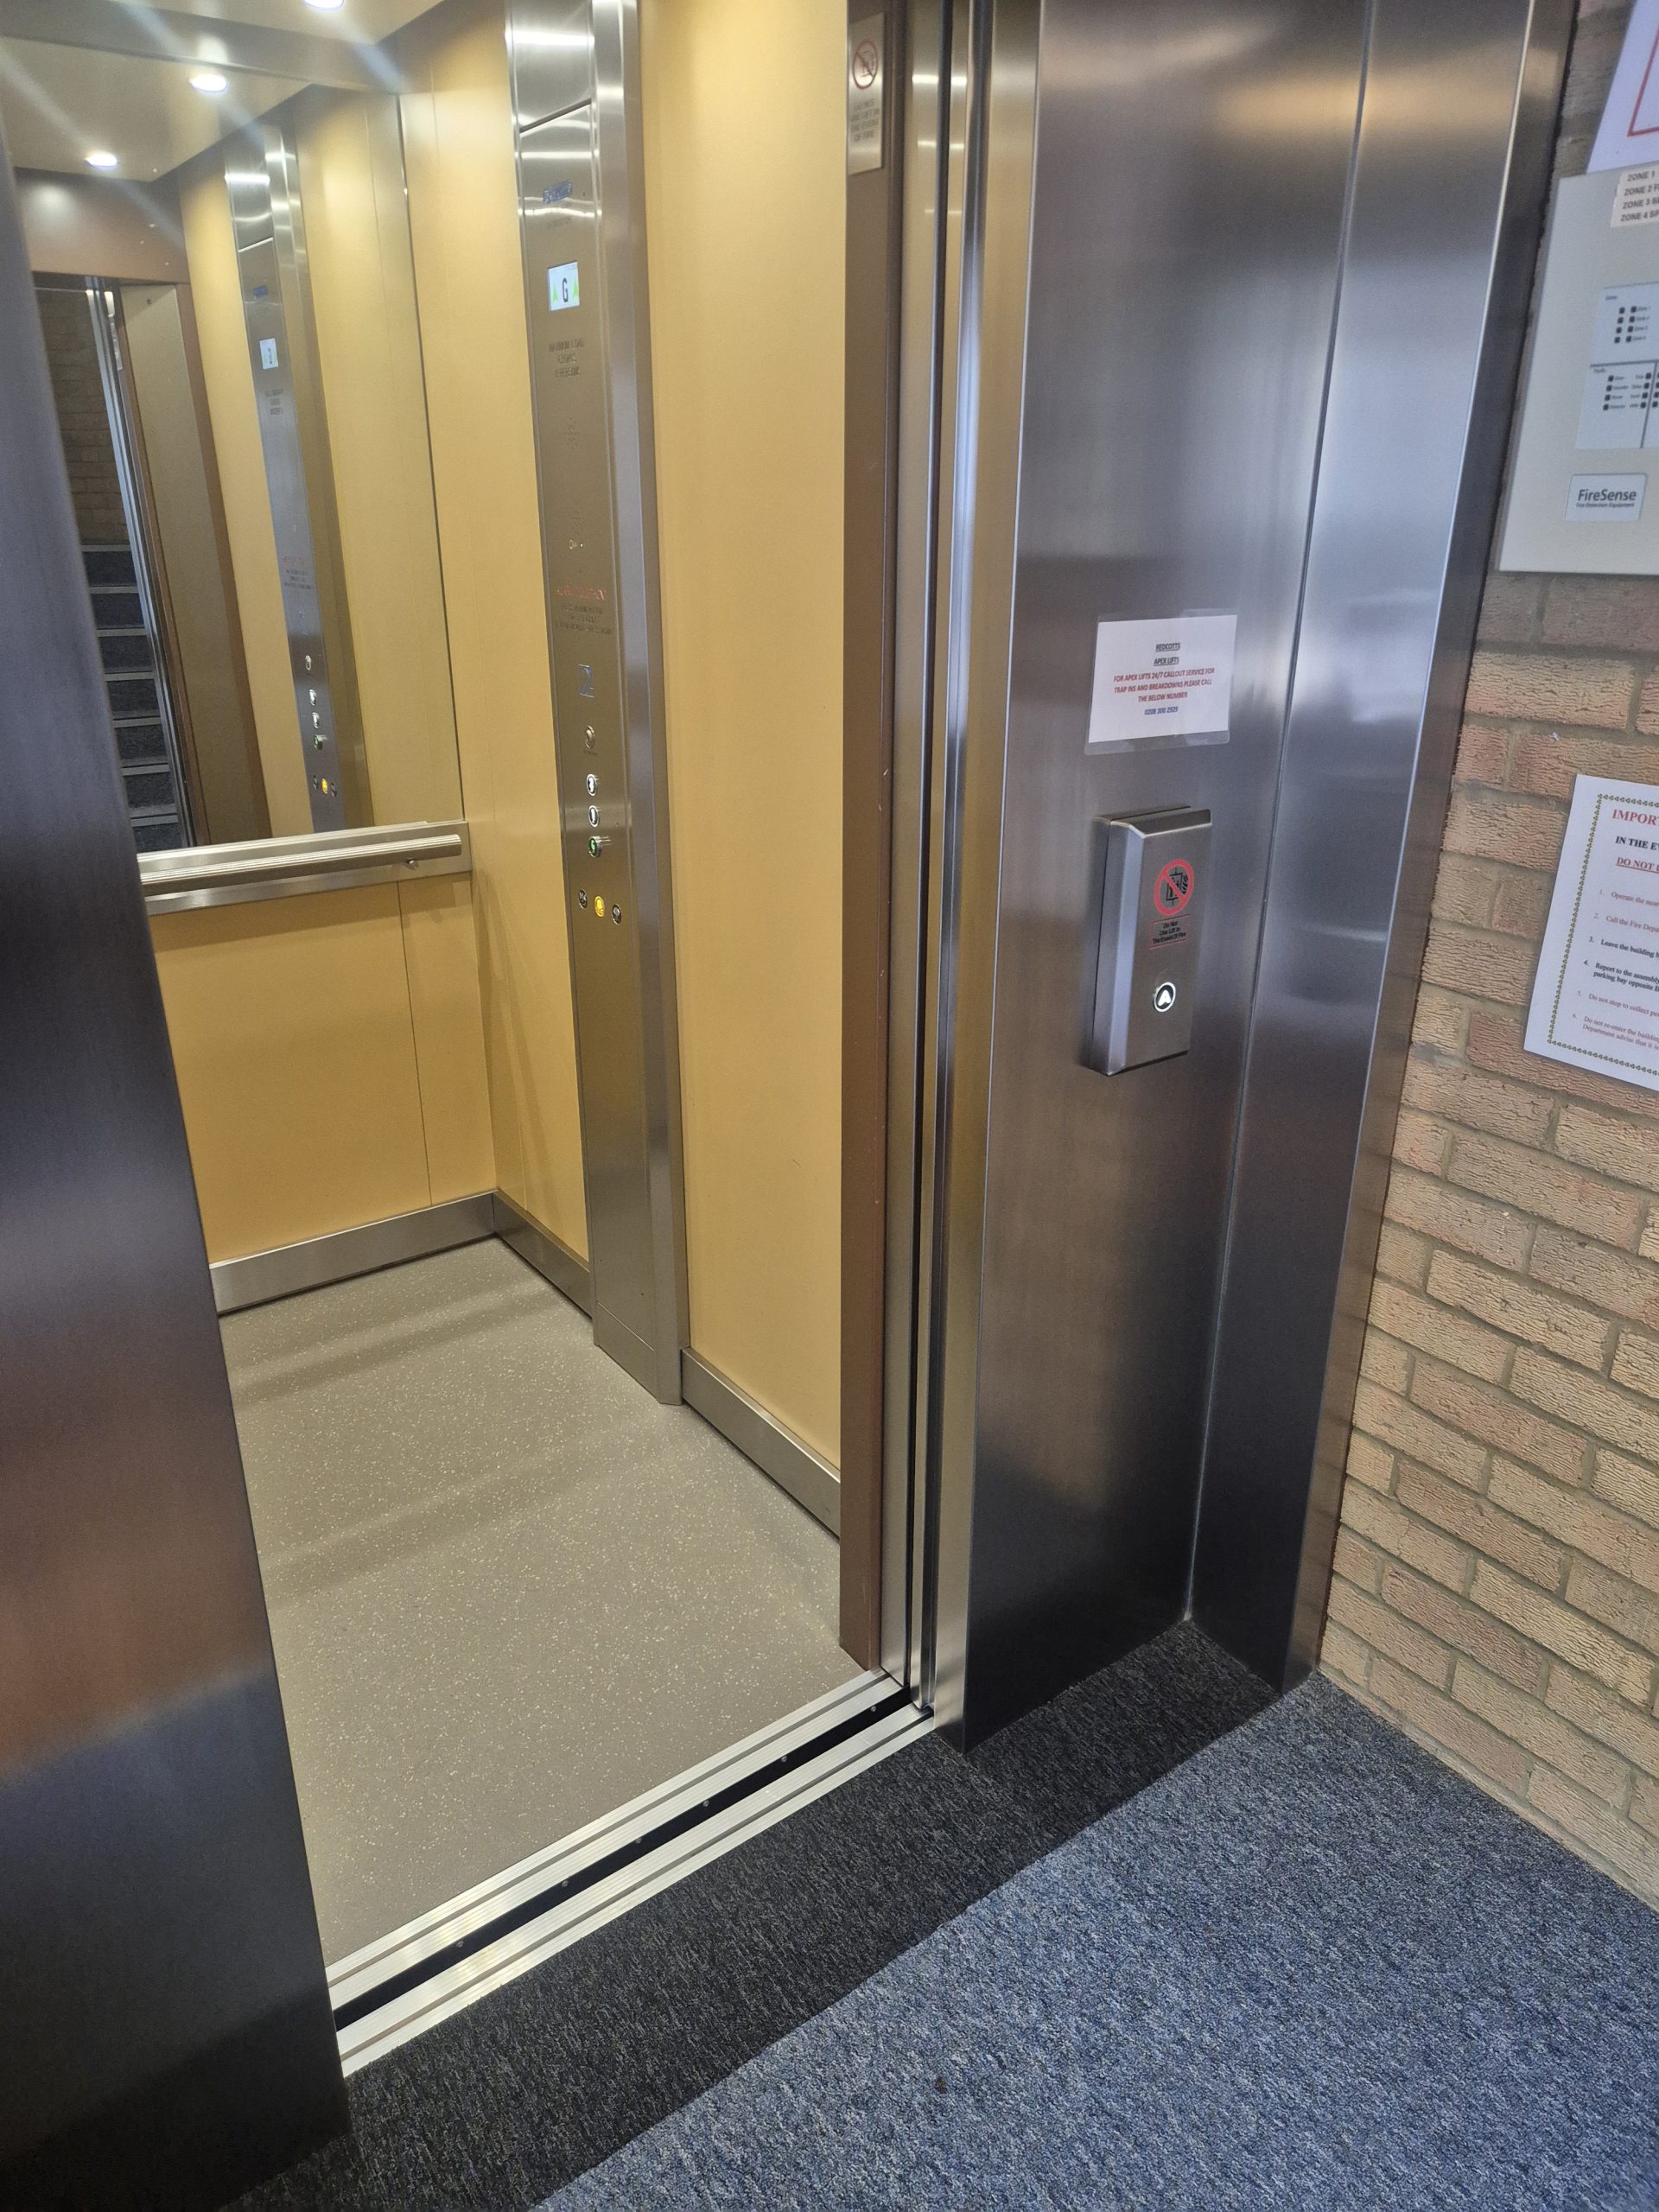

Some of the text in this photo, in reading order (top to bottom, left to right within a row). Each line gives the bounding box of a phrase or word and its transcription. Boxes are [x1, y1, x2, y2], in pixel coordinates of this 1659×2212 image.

[1627, 171, 1649, 181] ZONE
[1624, 186, 1645, 196] ZONE
[1623, 200, 1643, 209] ZONE
[1620, 213, 1642, 222] ZONE
[562, 277, 569, 303] G
[1578, 488, 1637, 502] FireSense
[1125, 673, 1139, 682] APEX
[1139, 671, 1151, 680] LIFTS
[1152, 671, 1163, 680] 24/7
[1164, 670, 1185, 678] CALLOUT
[1186, 668, 1205, 677] SERVICE
[1205, 667, 1216, 676] FOR
[1115, 685, 1128, 694] TRAP
[1184, 679, 1201, 688] PLEASE
[1202, 677, 1213, 686] CALL
[1166, 692, 1188, 701] NUMBER
[1612, 809, 1659, 827] IMPOR
[1616, 836, 1626, 845] IN
[1629, 838, 1649, 849] THE
[1617, 856, 1631, 867] DO
[1633, 860, 1655, 870] NOT
[1611, 892, 1634, 902] Operate
[1605, 915, 1618, 924] Call
[1630, 920, 1643, 929] Fire
[1601, 938, 1618, 949] Leave
[1630, 946, 1655, 958] building
[1596, 963, 1615, 974] Report
[1593, 971, 1616, 982] parking
[1617, 976, 1627, 985] bay
[1628, 980, 1653, 991] opposite
[1589, 993, 1598, 1001] Do
[1609, 998, 1622, 1008] stop
[1630, 1005, 1649, 1014] collect
[1584, 1015, 1592, 1024] Do
[1605, 1022, 1627, 1034] re-enter
[1628, 1027, 1637, 1036] the
[1583, 1023, 1616, 1038] Department
[1617, 1033, 1635, 1043] advise
[1636, 1036, 1647, 1046] that
